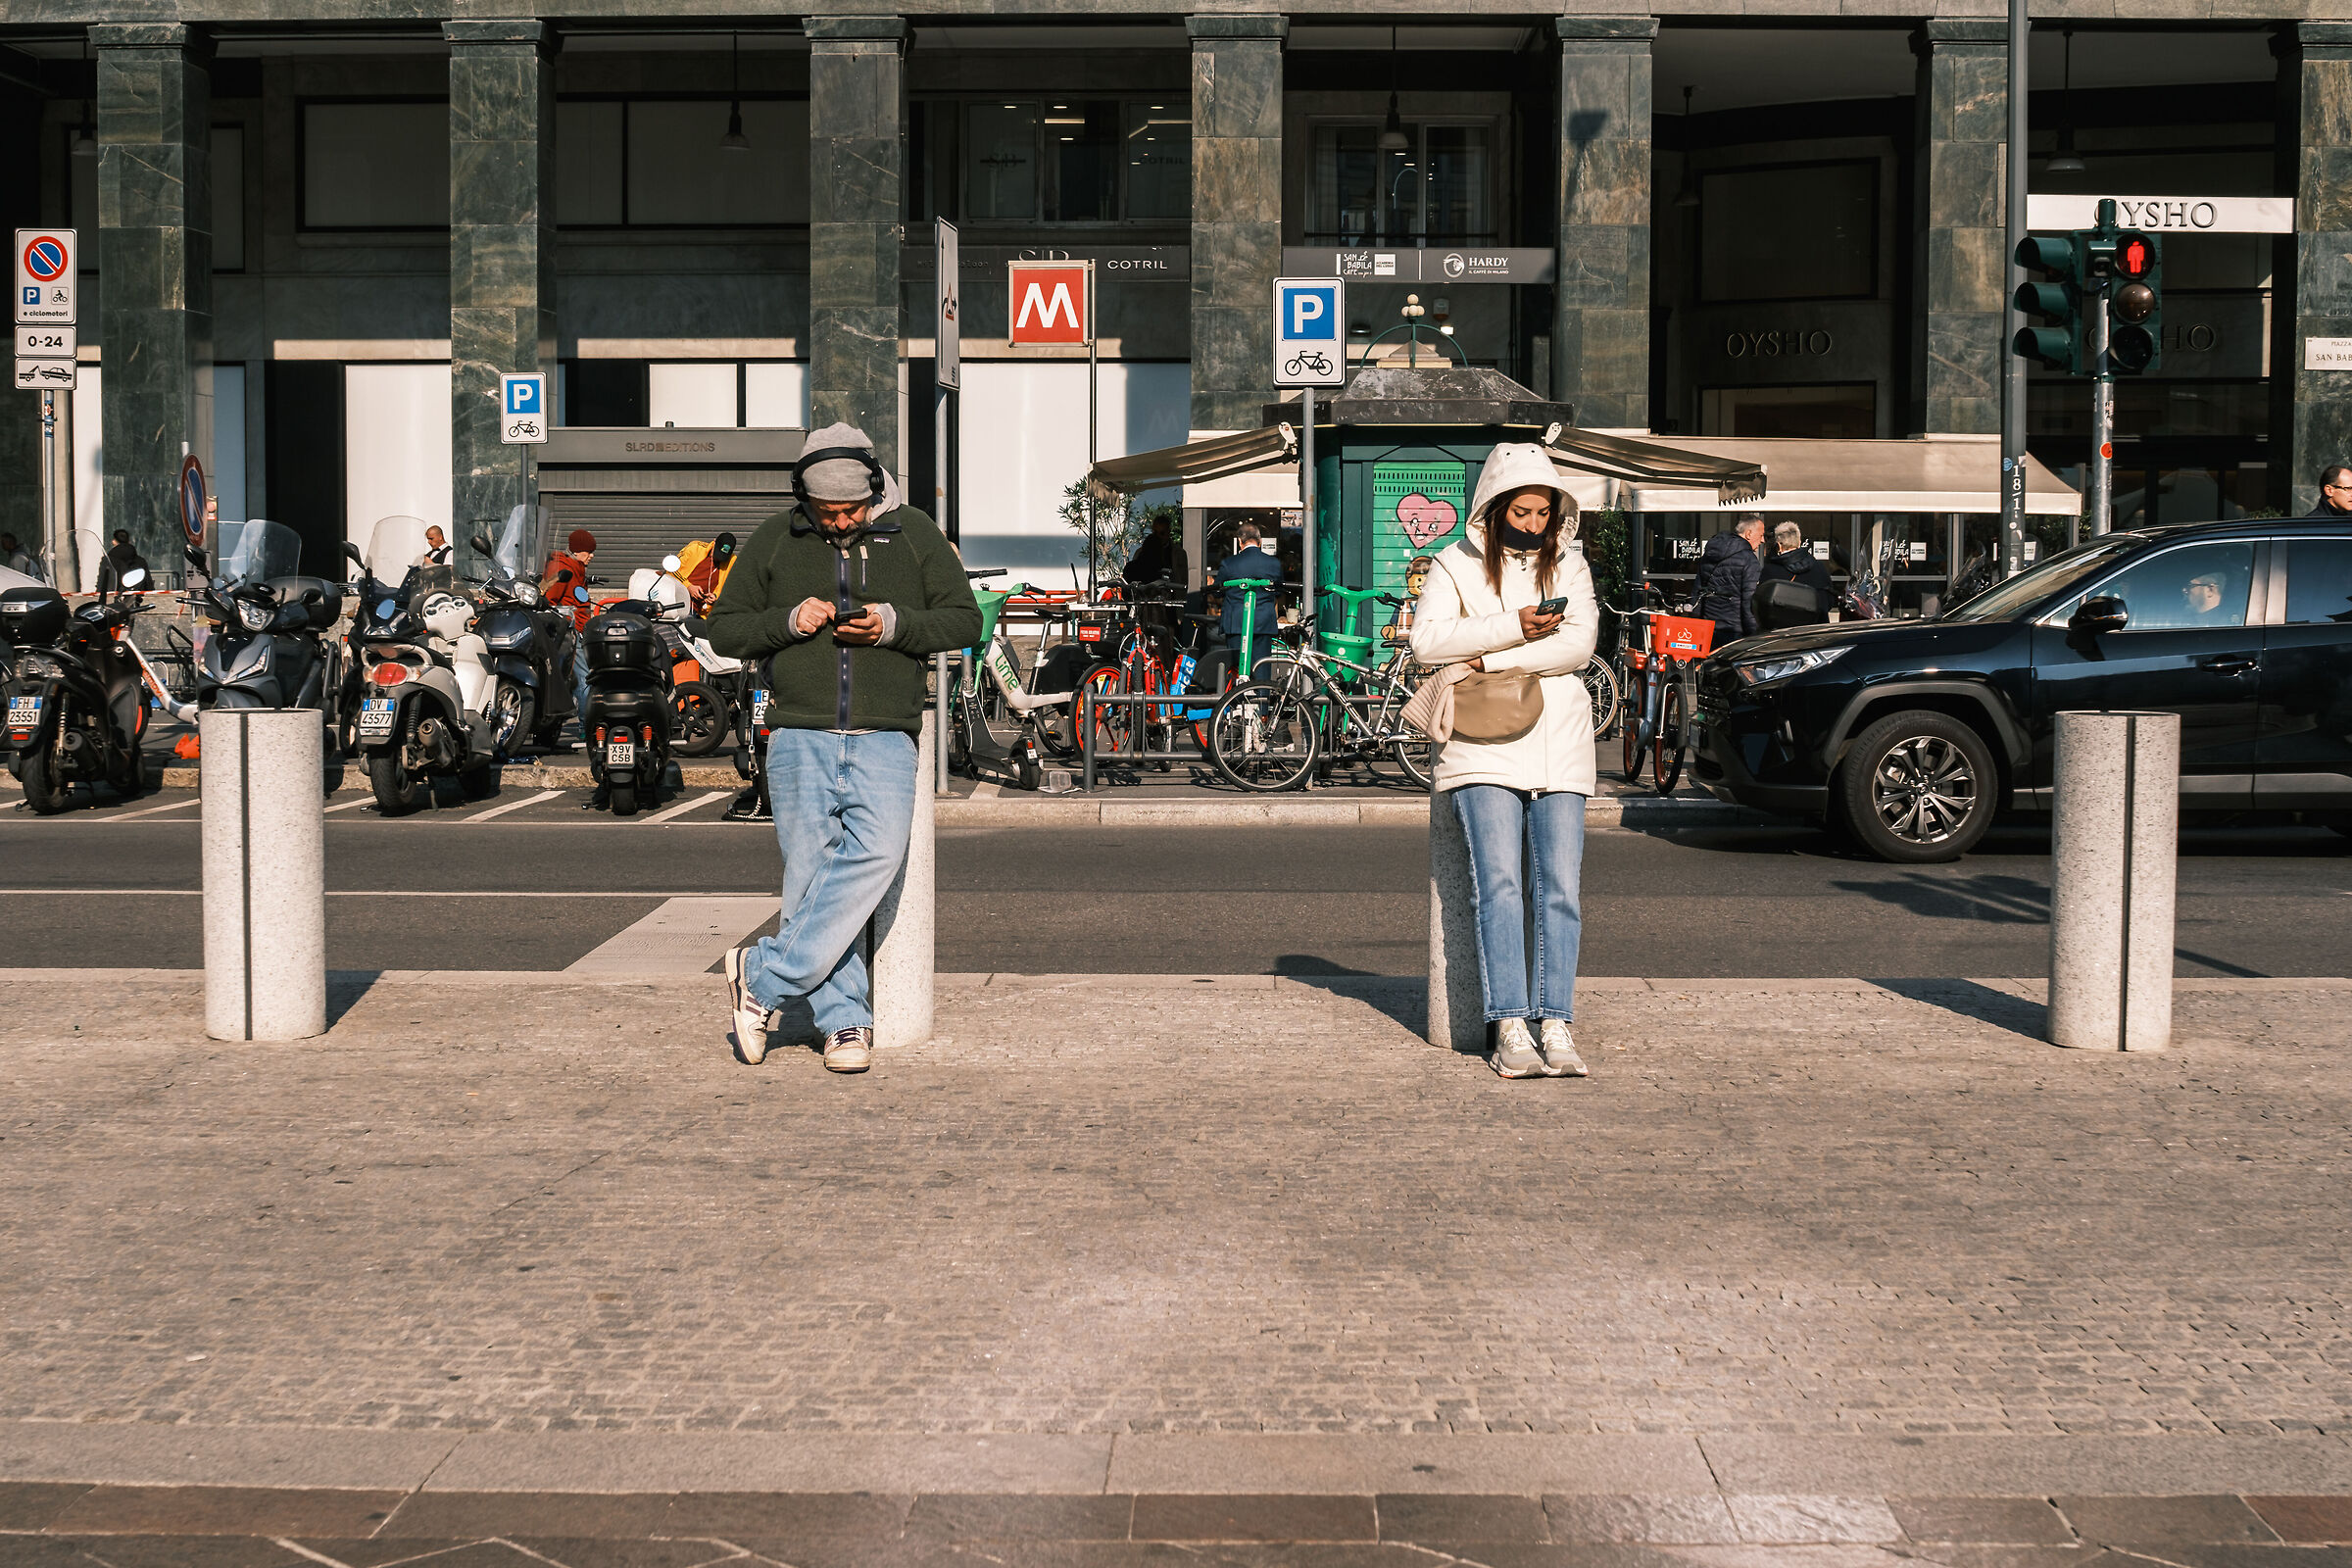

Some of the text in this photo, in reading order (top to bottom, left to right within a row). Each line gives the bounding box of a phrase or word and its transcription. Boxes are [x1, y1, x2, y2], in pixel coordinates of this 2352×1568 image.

[1106, 260, 1168, 270] COTRIL
[1347, 261, 1372, 270] BABILA
[1468, 257, 1509, 267] HARDY
[25, 289, 37, 303] P
[1015, 282, 1080, 328] M
[1294, 294, 1324, 333] P
[27, 335, 64, 348] 0-24
[1727, 330, 1833, 358] OYSHO
[2315, 353, 2332, 362] SAN
[513, 383, 534, 410] P
[995, 652, 1019, 691] Lime
[17, 697, 29, 708] FH
[369, 699, 383, 710] DV
[9, 710, 37, 723] 23551
[362, 712, 392, 724] 43577
[612, 745, 631, 754] X9V
